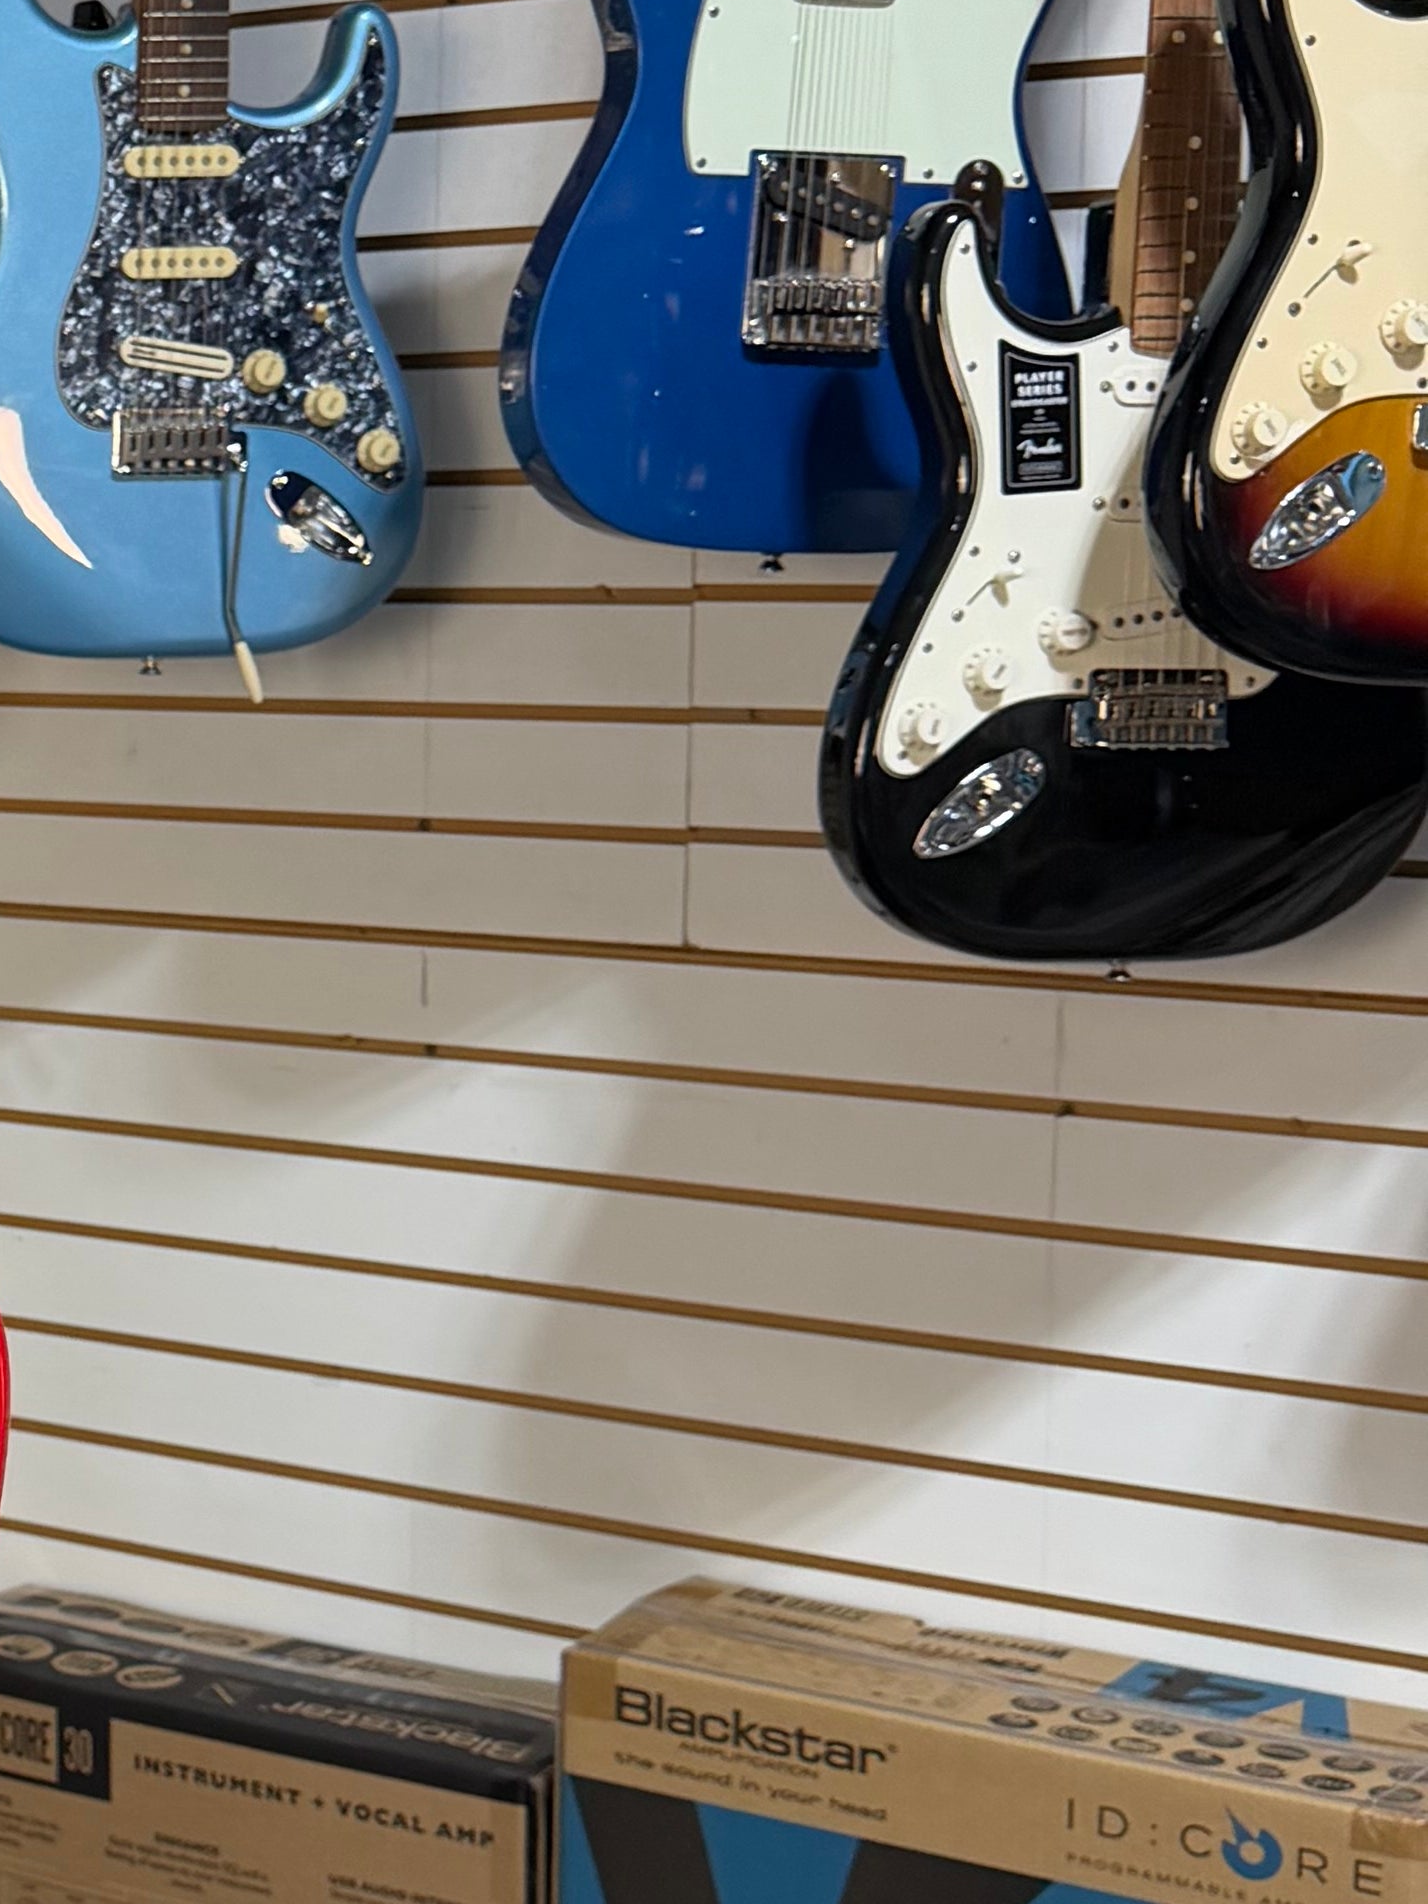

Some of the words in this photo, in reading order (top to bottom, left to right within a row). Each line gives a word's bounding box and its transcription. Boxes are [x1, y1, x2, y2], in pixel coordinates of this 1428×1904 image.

[1014, 369, 1065, 385] PLAYER
[1016, 382, 1064, 398] SERIES
[614, 1684, 889, 1774] Blackstar
[133, 1753, 301, 1807] INSTRUMENT
[334, 1797, 427, 1836] VOCAL
[434, 1821, 496, 1850] AMP
[615, 1751, 656, 1772] the
[660, 1763, 733, 1790] sound
[738, 1777, 762, 1795] in
[766, 1784, 824, 1806] your
[828, 1797, 889, 1822] head
[1065, 1852, 1247, 1904] PROGRAMMABLE
